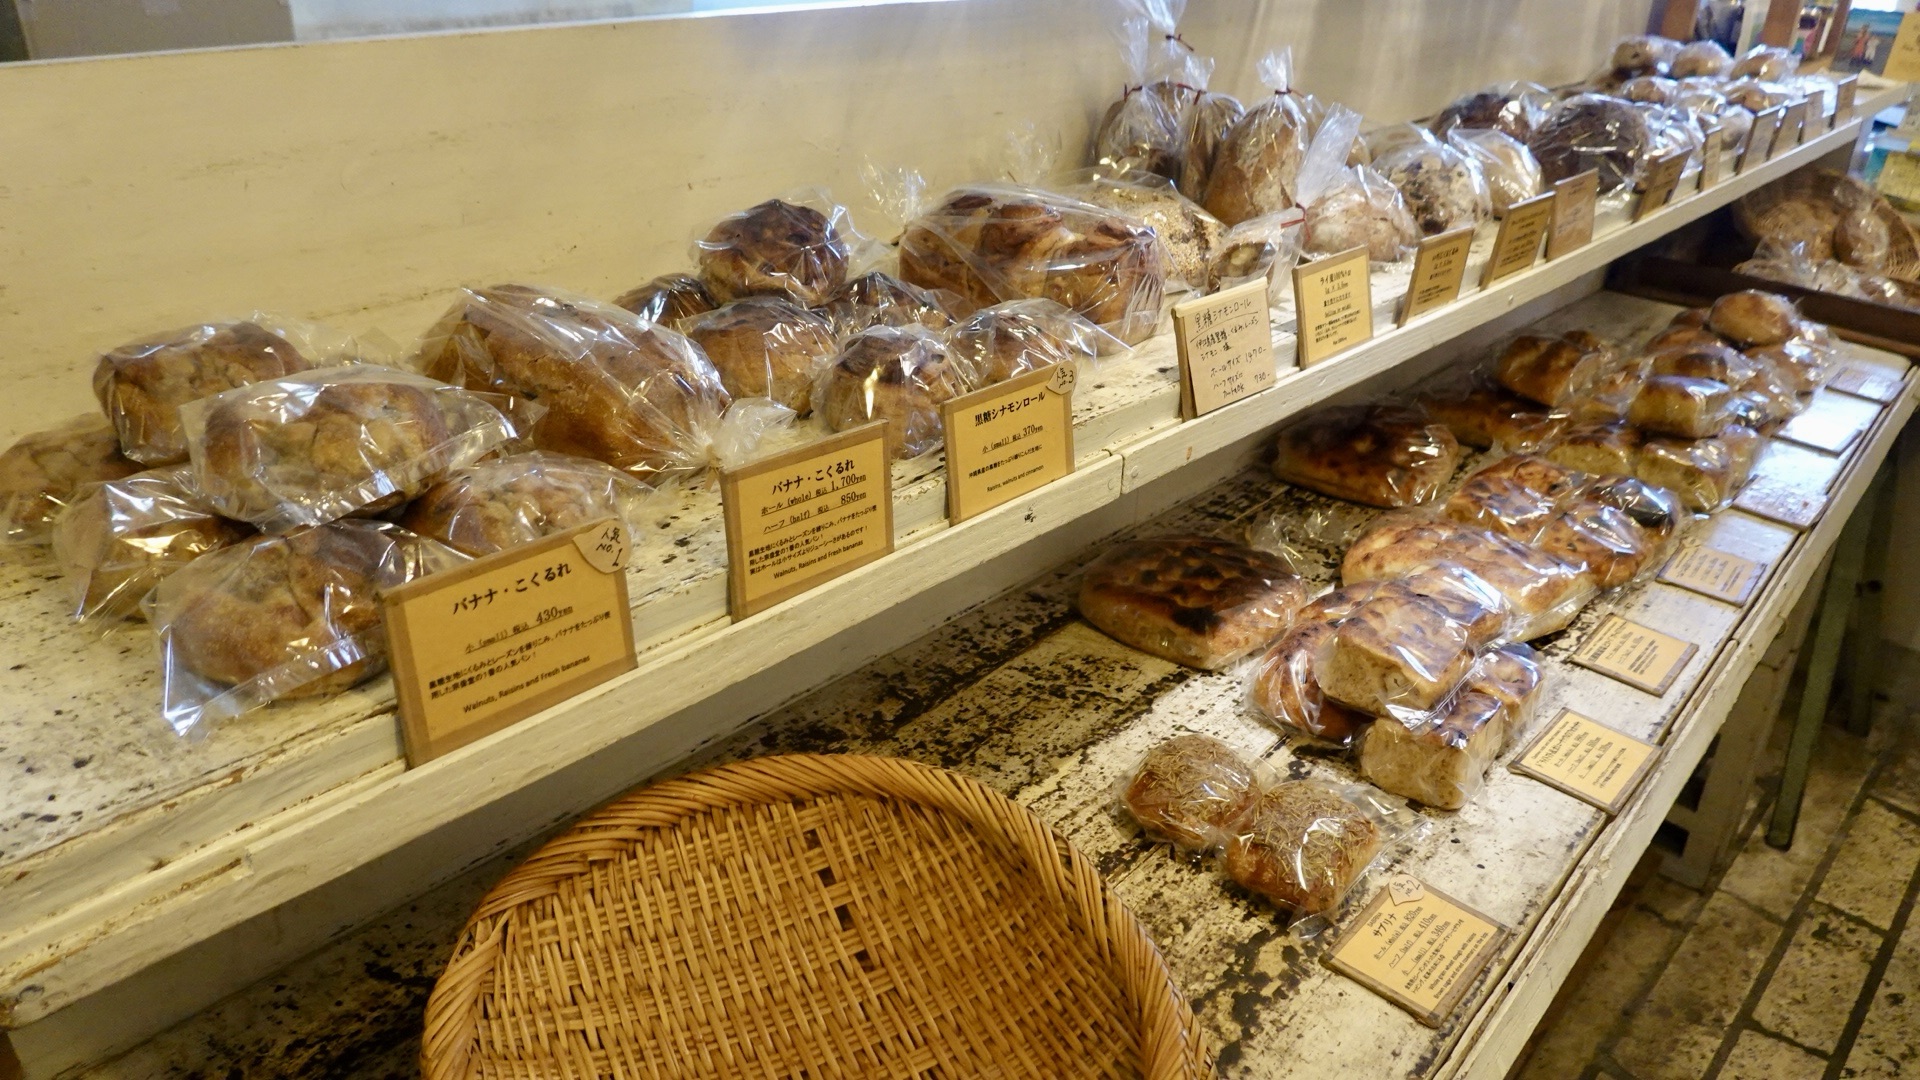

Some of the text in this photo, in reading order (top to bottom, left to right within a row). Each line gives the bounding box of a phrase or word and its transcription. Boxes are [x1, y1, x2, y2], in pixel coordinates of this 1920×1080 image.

[975, 392, 1045, 426] 黒糖シナモンロール
[982, 445, 989, 453] 小
[772, 459, 854, 494] バナナ・こくるれ
[761, 502, 784, 516] ホール
[787, 491, 813, 508] (whole)
[763, 519, 787, 535] ハーフ
[789, 510, 811, 525] (half)
[601, 527, 620, 544] 人気
[773, 540, 864, 579] Walnuts, Raisins and Fresh bananas
[454, 563, 571, 614] バナナ・こくるれ
[465, 643, 476, 655] 小
[463, 655, 590, 713] Walnuts, Raisins and Fresh bananas
[1373, 946, 1387, 960] ホール
[1388, 953, 1403, 969] ハーフ
